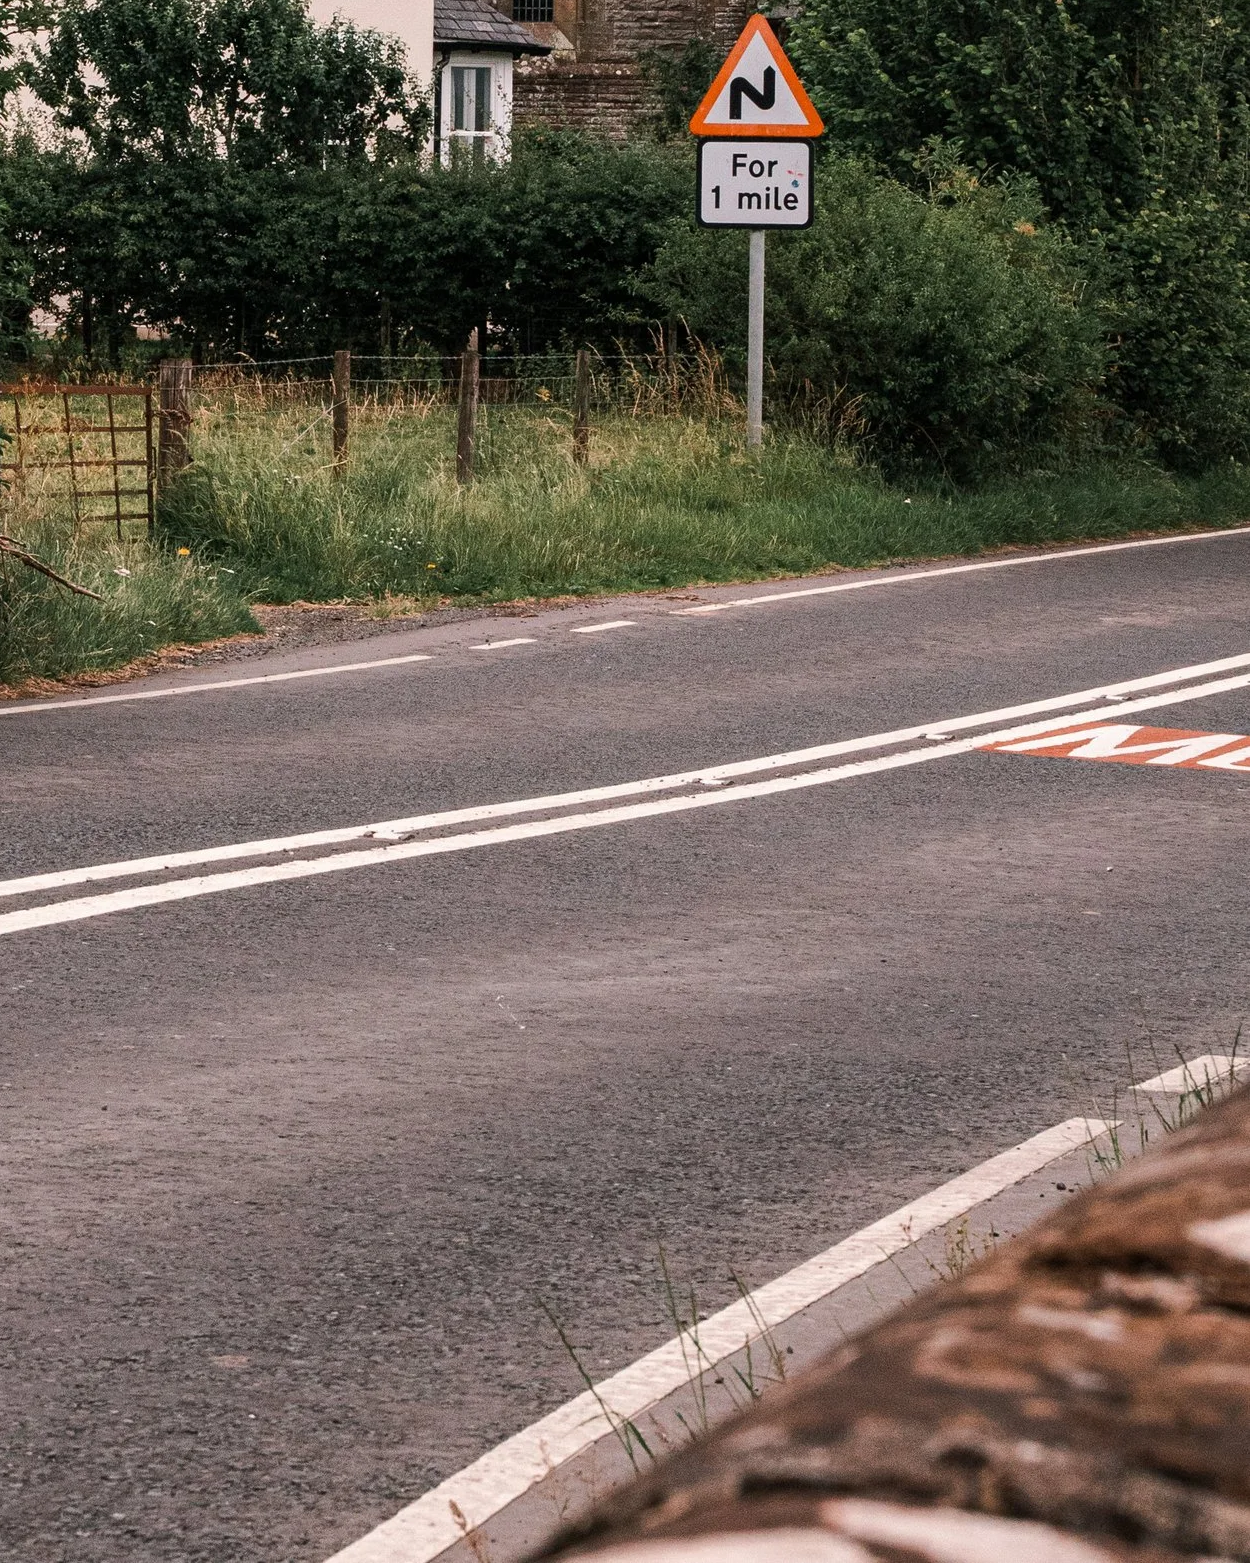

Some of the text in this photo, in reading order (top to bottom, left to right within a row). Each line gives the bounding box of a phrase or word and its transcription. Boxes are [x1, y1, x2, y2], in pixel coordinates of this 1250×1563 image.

[732, 153, 779, 178] For
[711, 185, 799, 211] 1 mile
